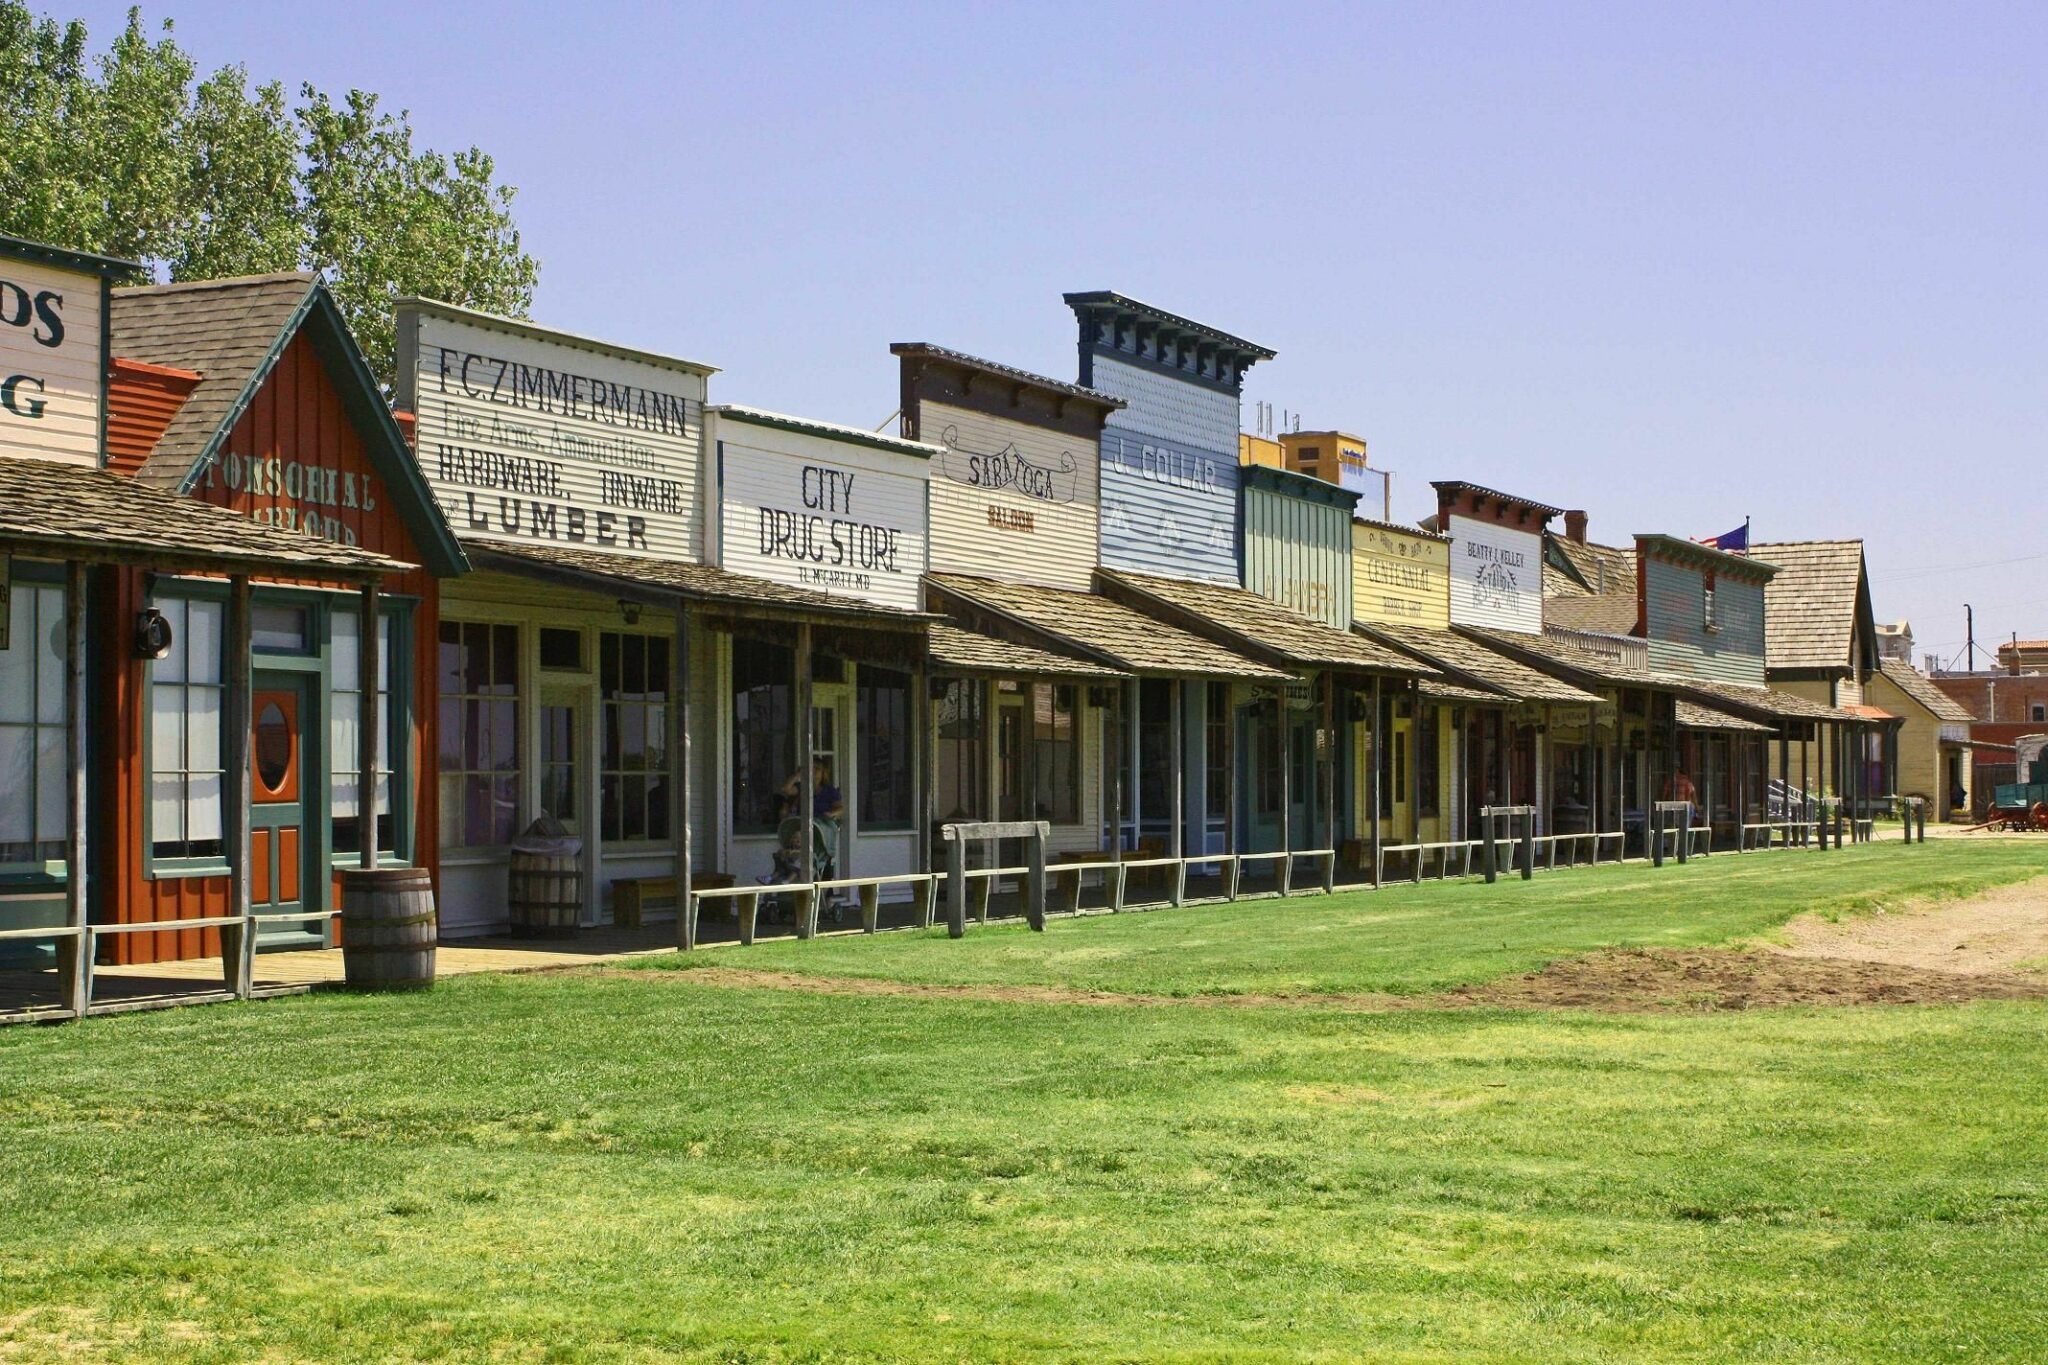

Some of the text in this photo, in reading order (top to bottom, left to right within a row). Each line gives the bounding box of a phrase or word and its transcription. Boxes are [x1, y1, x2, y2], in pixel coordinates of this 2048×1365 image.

[0, 281, 64, 348] DS
[1, 375, 48, 418] G
[489, 359, 688, 437] ZIMMERMANN
[444, 402, 481, 439] Fire
[599, 469, 684, 514] TINWARE
[802, 466, 855, 514] CITY
[968, 453, 1054, 499] SARATOGA
[1141, 444, 1216, 494] COLLAR
[466, 491, 649, 550] LUMBER
[759, 506, 901, 573] DRUG STORE
[1467, 541, 1492, 561] BEATTY
[1368, 559, 1432, 592] CENTENNIAL
